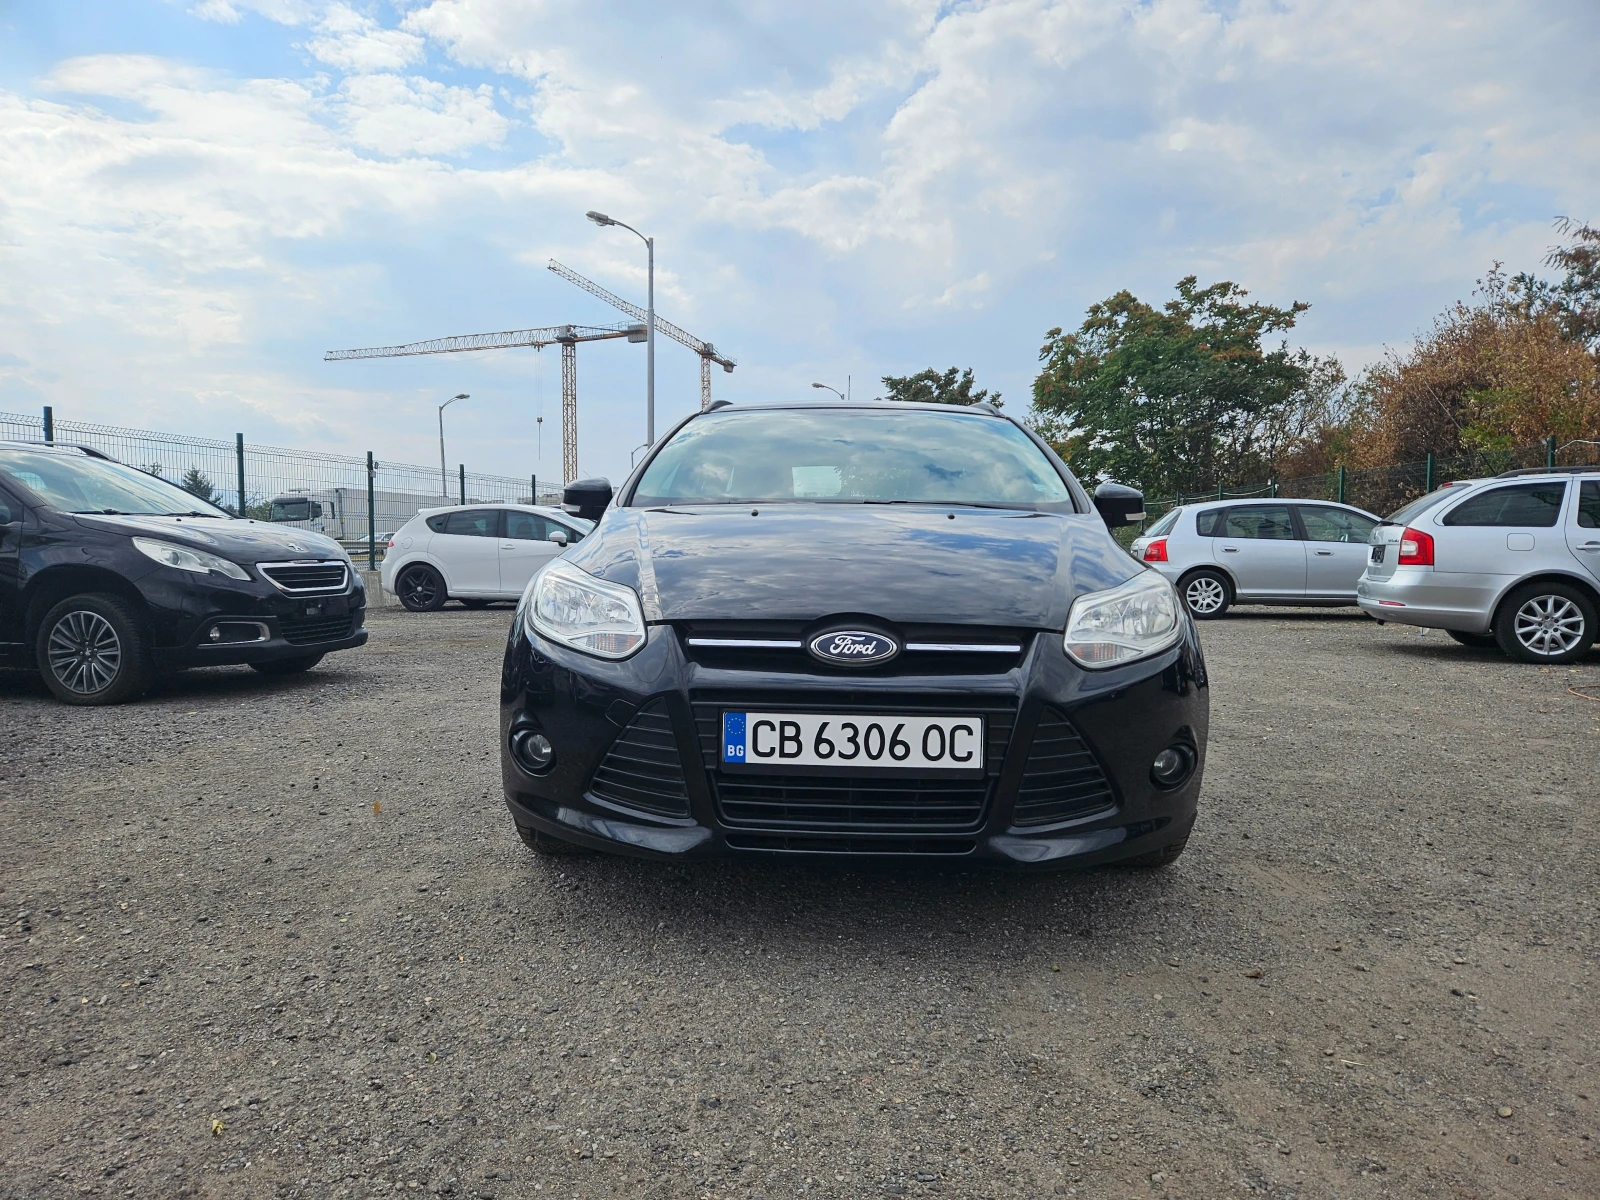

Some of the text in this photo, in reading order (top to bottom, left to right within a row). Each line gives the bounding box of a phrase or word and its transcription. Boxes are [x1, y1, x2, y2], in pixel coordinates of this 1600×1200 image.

[830, 635, 877, 655] Ford
[727, 744, 744, 757] BG
[752, 719, 974, 763] CB 6306 OC
